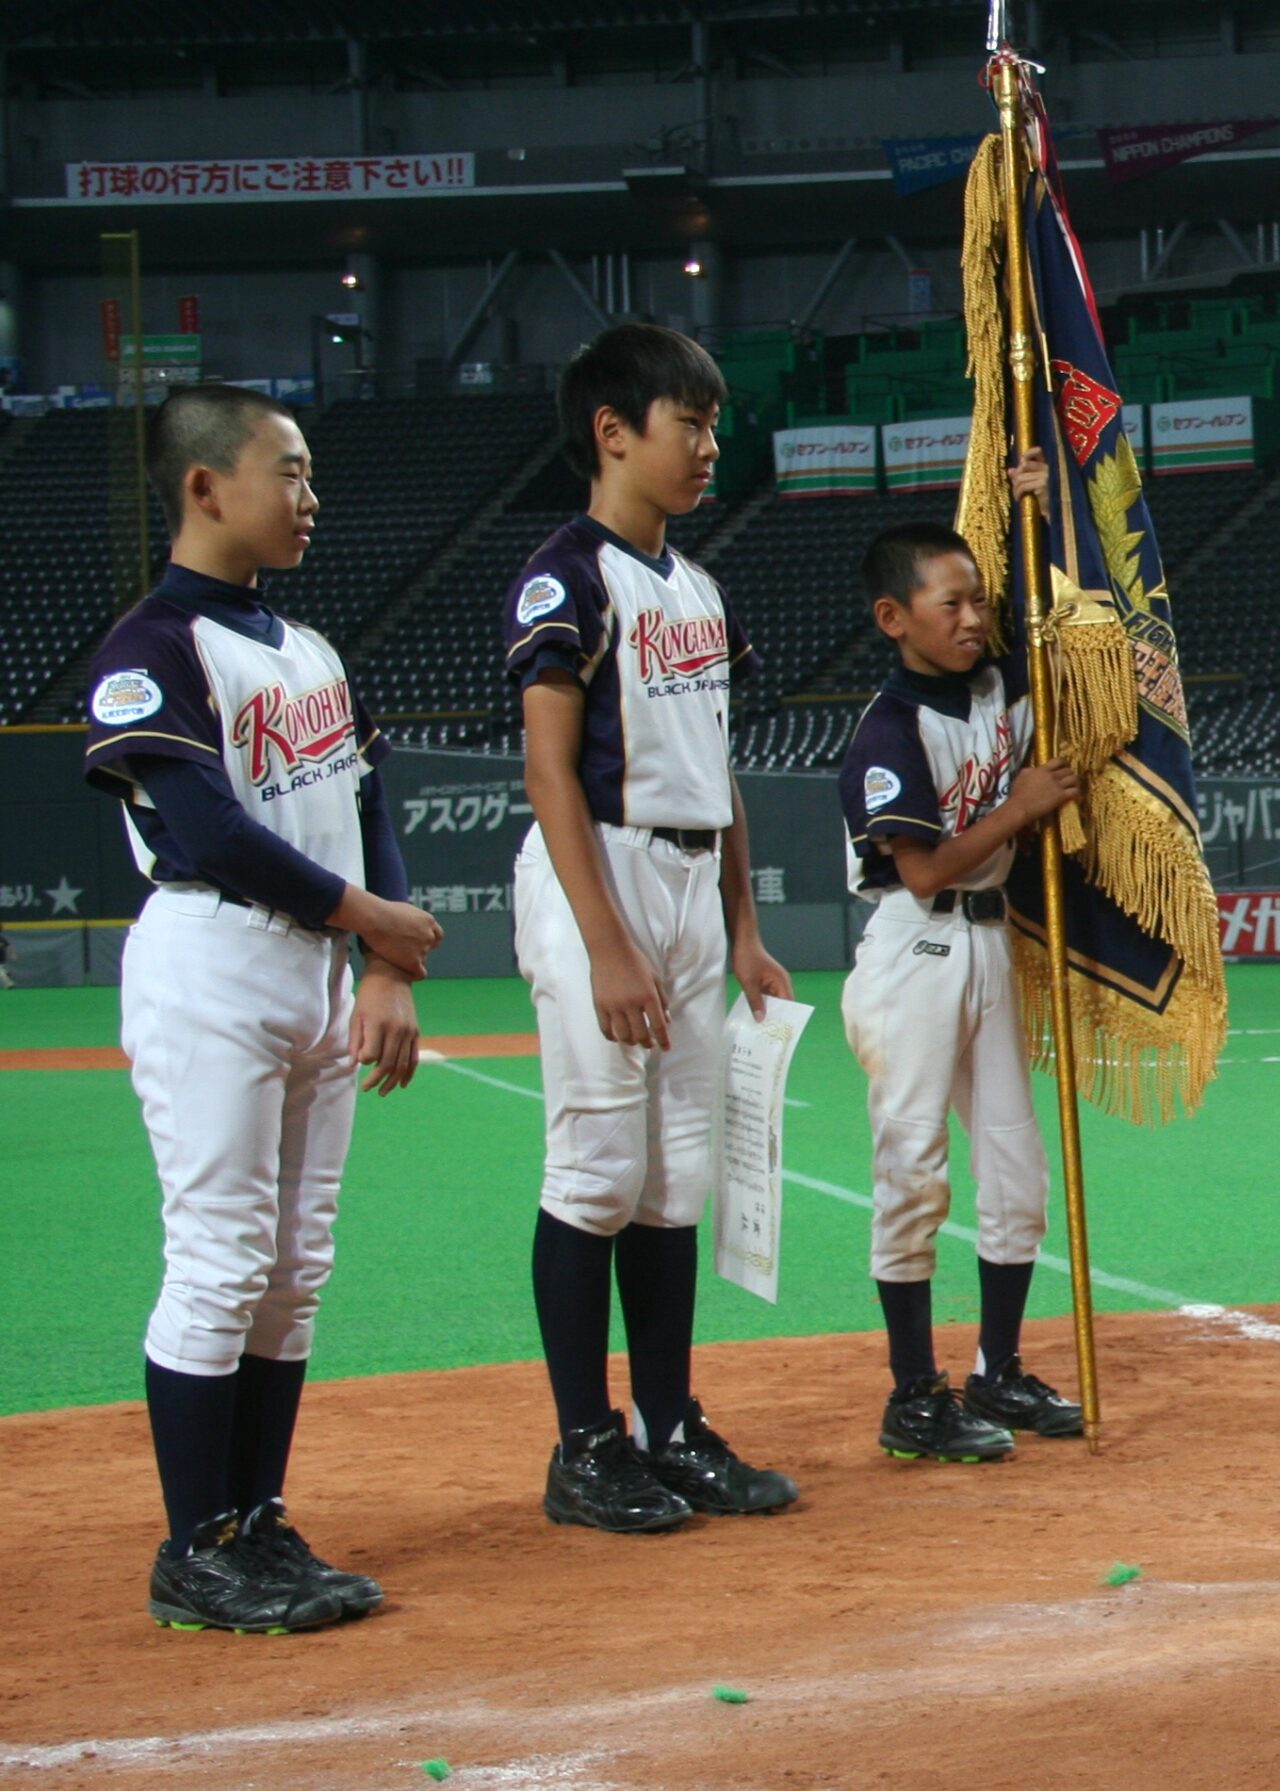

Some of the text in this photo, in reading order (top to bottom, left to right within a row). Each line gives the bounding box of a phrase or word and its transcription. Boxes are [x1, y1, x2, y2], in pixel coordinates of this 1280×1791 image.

[1111, 140, 1160, 163] NIPPON
[1159, 124, 1235, 154] CHAMPIONS
[647, 681, 692, 698] BLACK
[261, 769, 323, 802] BLACK
